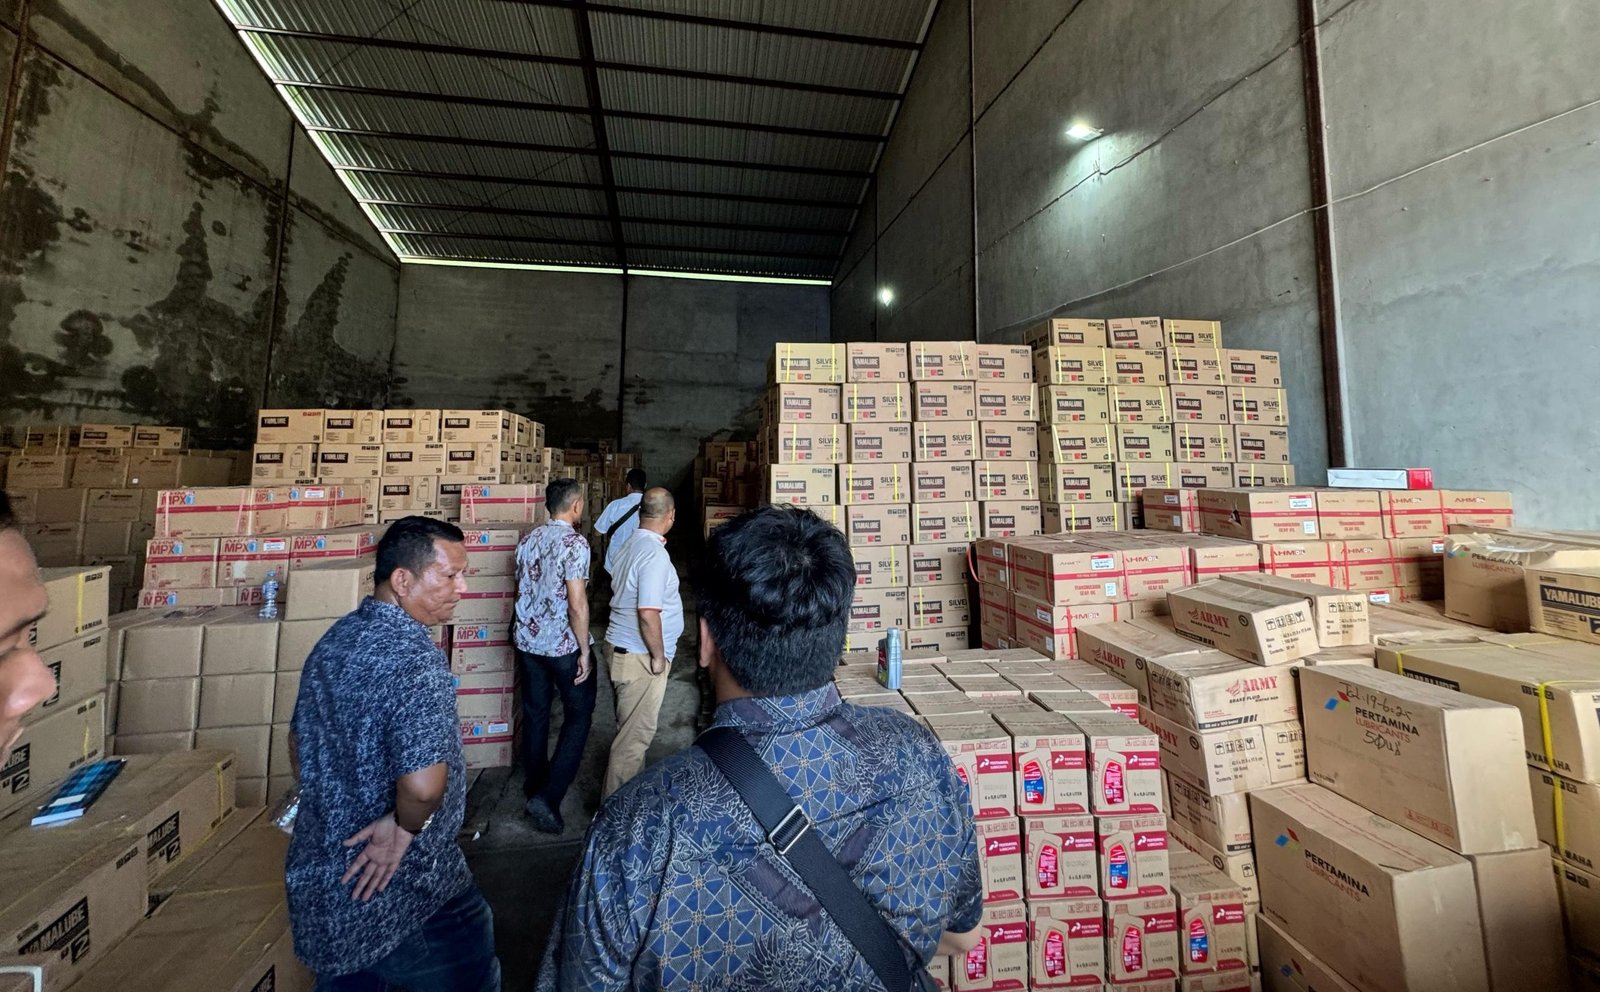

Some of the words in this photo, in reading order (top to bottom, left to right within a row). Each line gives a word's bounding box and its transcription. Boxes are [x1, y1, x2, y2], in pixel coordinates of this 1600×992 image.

[783, 359, 810, 367] YMALUBE
[850, 398, 874, 406] YMALUBE
[778, 482, 806, 490] YAMALUBE
[916, 560, 940, 568] YAMALUBE
[852, 607, 880, 615] YAMALUBE
[1198, 612, 1229, 628] ARMY
[1102, 650, 1126, 669] ARMY
[1242, 676, 1278, 692] ARMY
[1356, 707, 1419, 736] PERTAMINA
[462, 726, 474, 736] PX
[1150, 724, 1178, 747] ARMY
[1356, 718, 1411, 743] LUBRICANTS
[1533, 752, 1571, 772] YAAHA
[1305, 849, 1369, 896] PERTAMINA
[1305, 860, 1361, 902] LUBRICANTS
